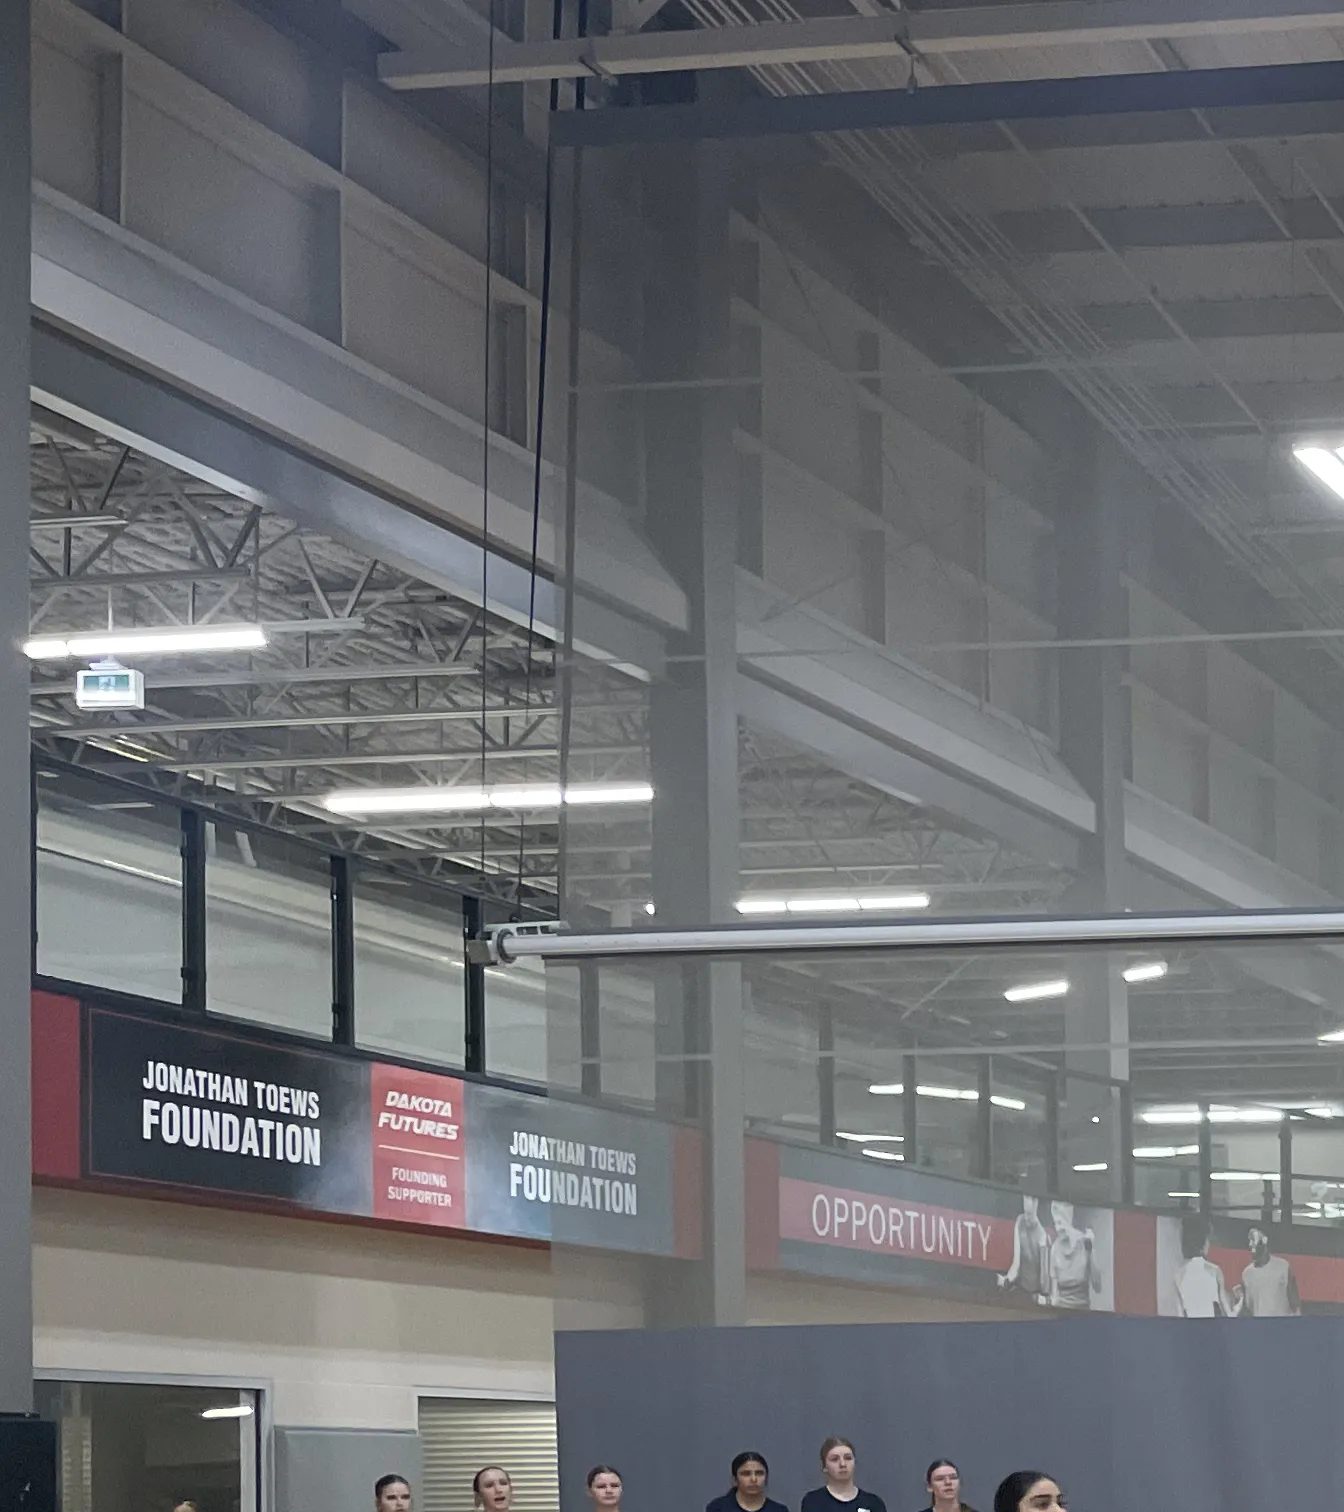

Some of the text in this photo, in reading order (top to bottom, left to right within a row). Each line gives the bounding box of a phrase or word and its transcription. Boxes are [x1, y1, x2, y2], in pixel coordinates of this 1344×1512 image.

[142, 1060, 320, 1119] JONATHAN TOEWS
[385, 1090, 452, 1118] DAKOTA
[142, 1098, 321, 1166] FOUNDATION
[378, 1111, 459, 1140] FUTURES
[509, 1131, 637, 1175] JONATHAN TOEWS
[387, 1185, 452, 1207] SUPPORTER
[391, 1166, 448, 1188] FOUNDING
[509, 1162, 637, 1216] FOUNDATION
[812, 1193, 991, 1261] OPPORTUNITY
